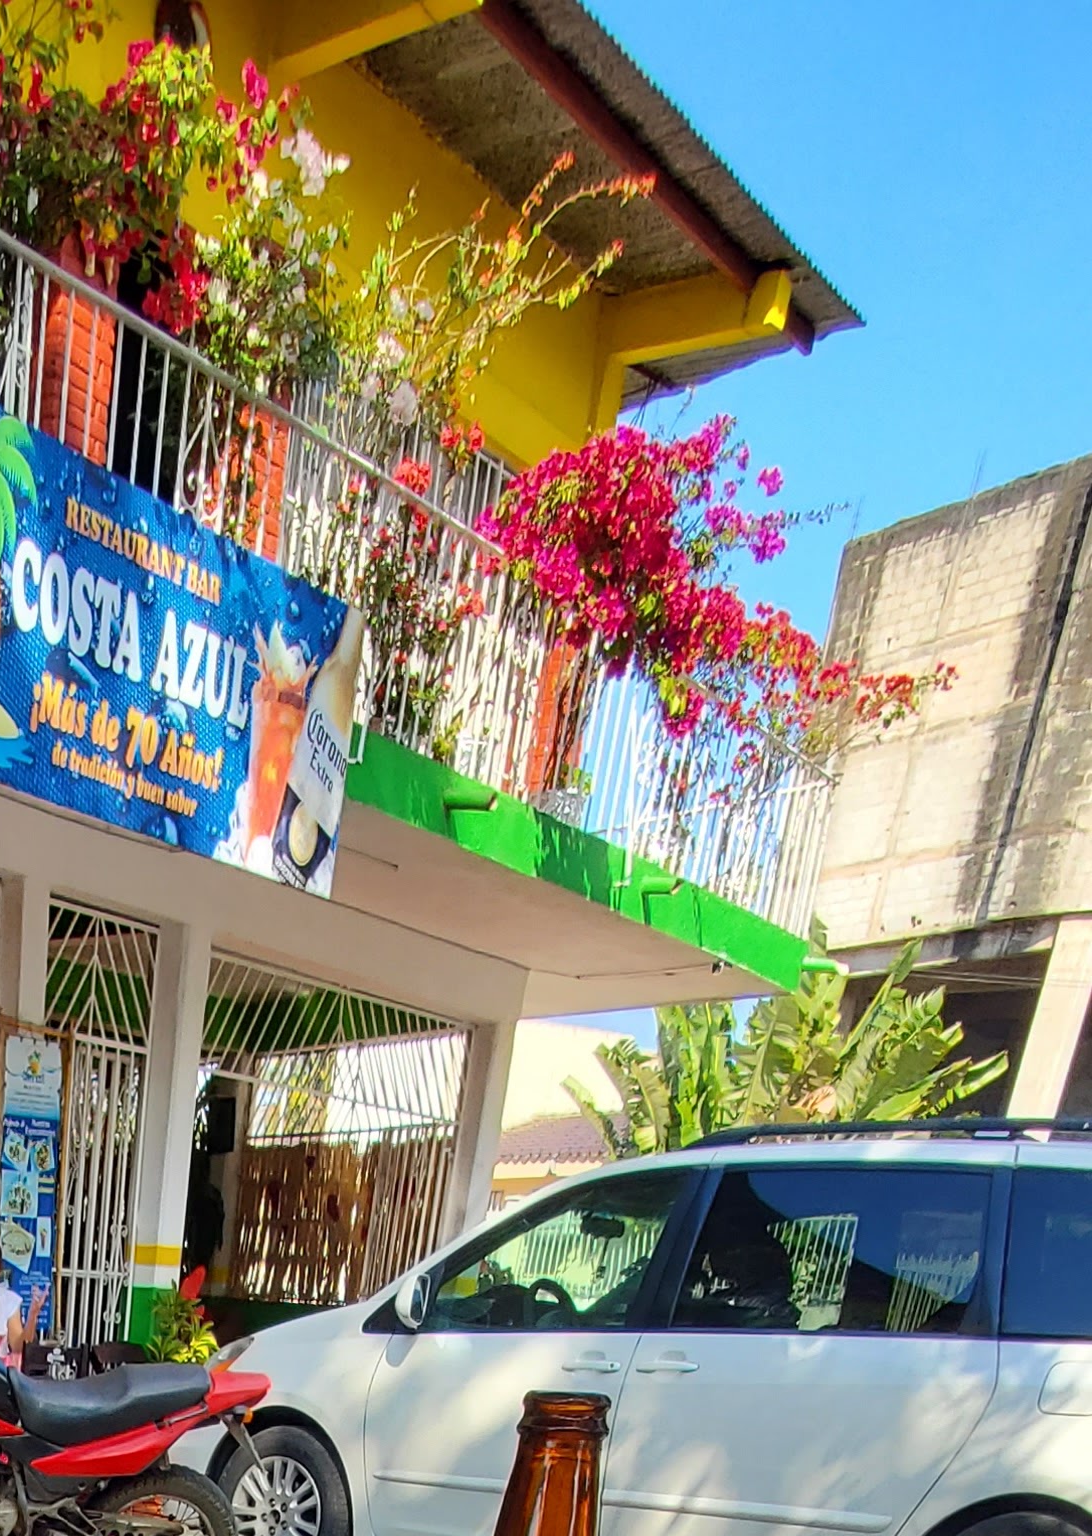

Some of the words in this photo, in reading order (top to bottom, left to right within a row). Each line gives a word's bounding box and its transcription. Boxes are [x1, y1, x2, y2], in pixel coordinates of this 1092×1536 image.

[65, 495, 186, 588] RESTAURANT
[186, 560, 222, 607] BAR
[11, 538, 143, 684] COSTA
[150, 609, 248, 730] AZUL
[29, 671, 87, 738] ¡Más
[91, 699, 121, 752] de
[125, 705, 158, 769] 70
[160, 729, 225, 793] Años!
[307, 708, 348, 777] Corona
[309, 744, 334, 795] Extra
[51, 742, 68, 768] de
[68, 749, 125, 792] tradición
[124, 773, 135, 799] y
[136, 772, 165, 805] buen
[166, 788, 199, 818] sabor
